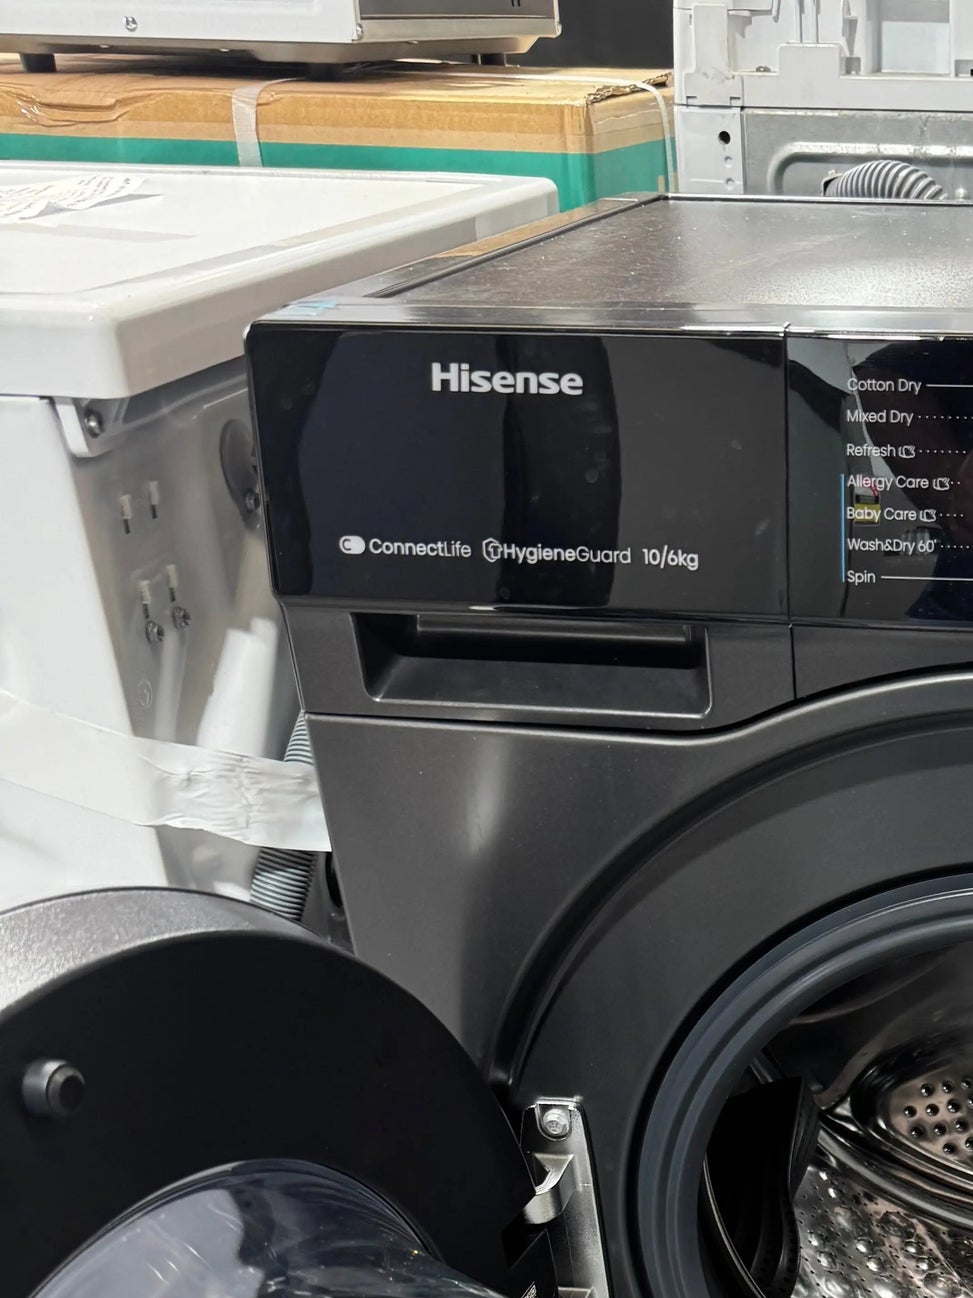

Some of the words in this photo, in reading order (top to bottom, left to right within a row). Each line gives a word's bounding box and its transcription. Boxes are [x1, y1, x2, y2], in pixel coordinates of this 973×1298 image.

[431, 362, 584, 396] Hisense
[847, 378, 895, 392] Cotton
[898, 378, 922, 395] Dry
[847, 410, 887, 423] Mixed
[890, 410, 914, 426] Dry
[847, 444, 896, 458] Refresh
[847, 475, 893, 490] Allergy
[895, 475, 929, 489] Care
[847, 507, 881, 523] Baby
[884, 508, 917, 521] Care
[369, 538, 472, 558] ConnectLife
[503, 542, 632, 566] HygieneGuard
[643, 545, 699, 571] 10/6kg
[847, 538, 914, 555] Wash&Dry
[847, 570, 876, 586] Spin
